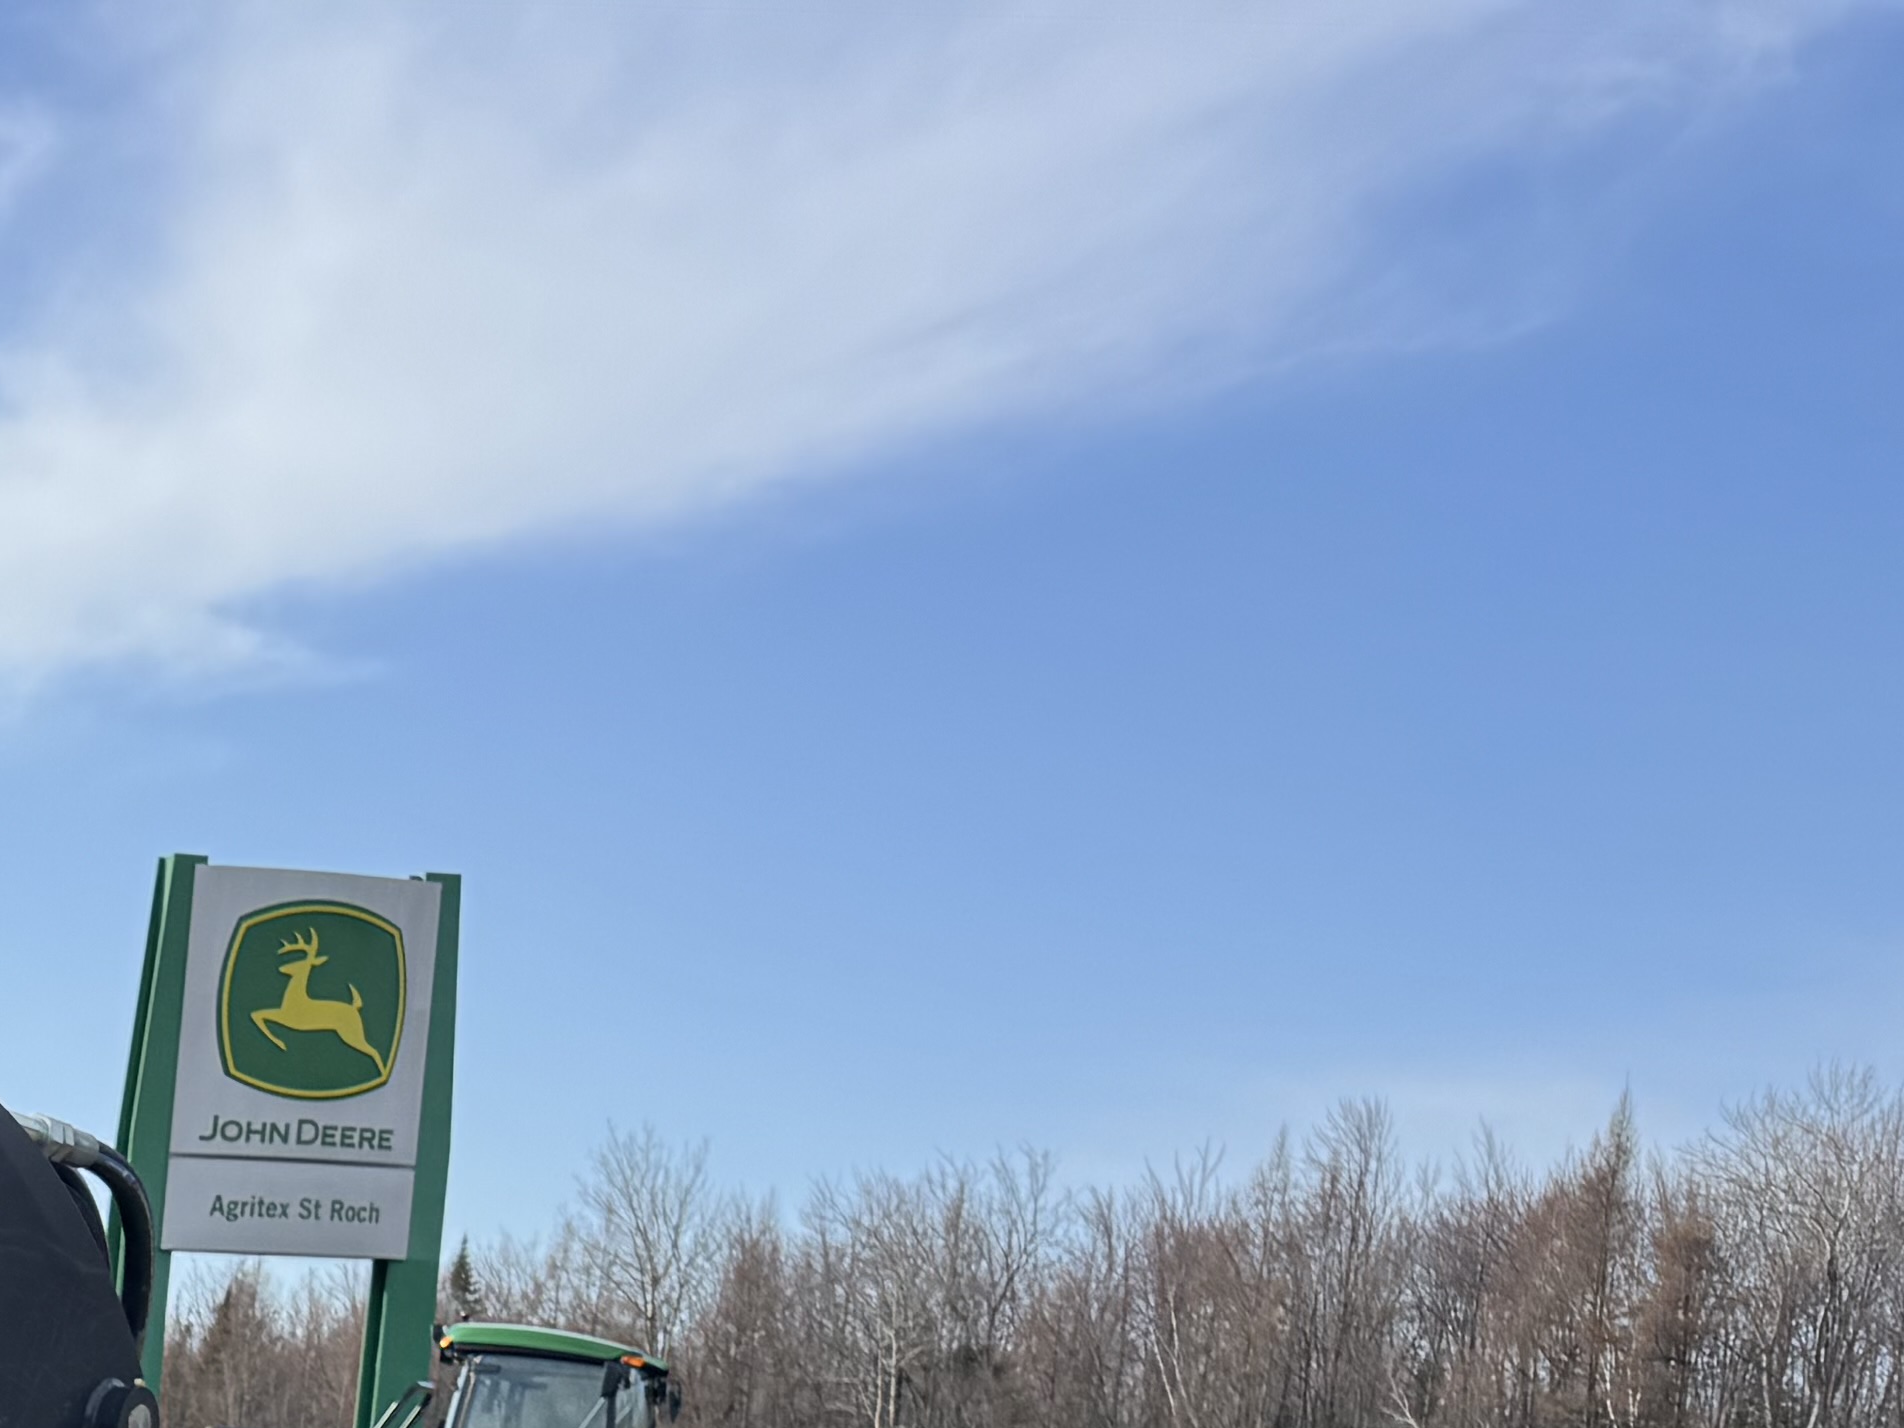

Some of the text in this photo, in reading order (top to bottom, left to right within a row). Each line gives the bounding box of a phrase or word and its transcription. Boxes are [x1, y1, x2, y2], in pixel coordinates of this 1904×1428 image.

[198, 1115, 394, 1151] JOHN DEERE
[209, 1195, 380, 1225] Agritex St Roch
